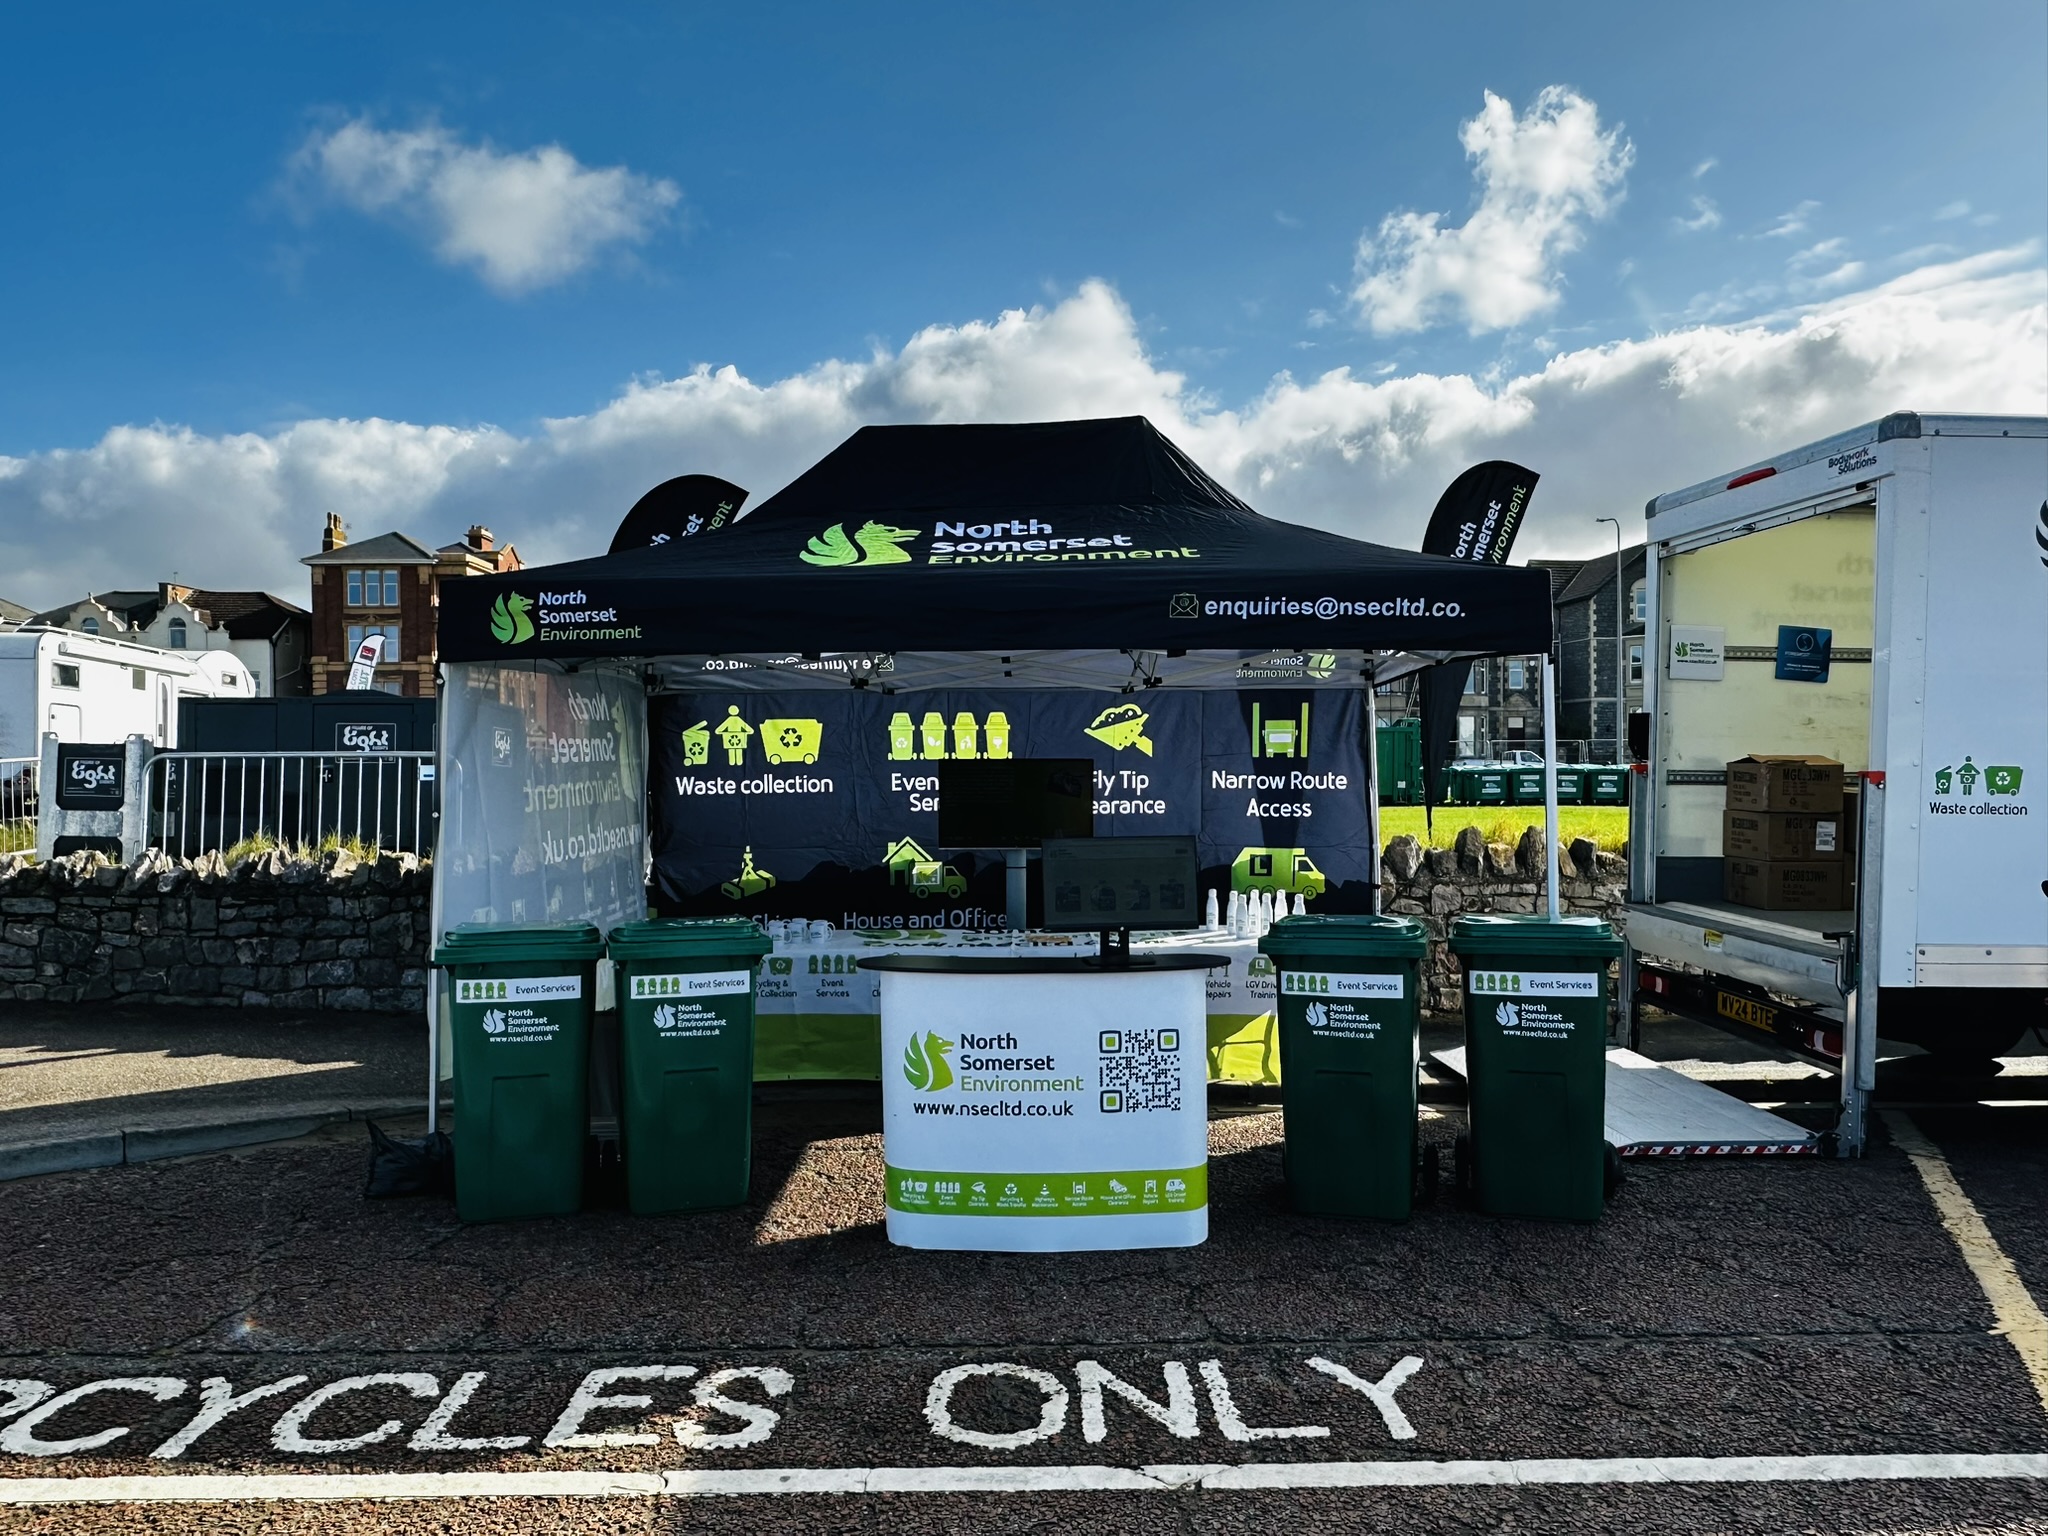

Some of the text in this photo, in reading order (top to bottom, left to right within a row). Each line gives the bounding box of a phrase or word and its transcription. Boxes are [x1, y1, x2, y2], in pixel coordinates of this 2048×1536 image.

[1828, 447, 1870, 468] Bodywork
[1838, 456, 1877, 474] Solutions
[934, 519, 1053, 538] North
[1472, 500, 1501, 561] merset
[930, 534, 1133, 553] Somerset
[1450, 522, 1477, 558] orth
[928, 547, 1200, 565] Environment
[539, 590, 586, 605] North
[539, 608, 617, 624] Somerset
[1204, 596, 1466, 620] enquiries@nsecltd.co.
[540, 625, 642, 641] Environment
[675, 773, 833, 796] Waste collection
[891, 772, 940, 791] Even
[1119, 770, 1149, 796] Tip
[1212, 770, 1348, 790] Narrow Route
[909, 793, 940, 812] Ser
[1092, 800, 1166, 815] earance
[1247, 798, 1312, 818] Access
[1929, 802, 2028, 815] Waste collection
[843, 908, 1007, 930] House and Office
[515, 984, 576, 995] Event Services
[688, 979, 745, 989] Event Services
[821, 979, 844, 987] Event
[1337, 980, 1398, 991] Event Services
[1529, 980, 1593, 989] Event Services
[760, 989, 797, 998] Collection
[816, 989, 850, 998] Services
[508, 1009, 533, 1017] North
[677, 1003, 702, 1012] North
[1329, 1003, 1354, 1012] North
[1521, 1003, 1547, 1011] North
[1751, 1003, 1773, 1027] BTE
[508, 1016, 548, 1025] Somerset
[677, 1011, 716, 1020] Somerset
[677, 1018, 727, 1028] Environment
[1329, 1012, 1369, 1021] Somerset
[1521, 1011, 1562, 1020] Somerset
[508, 1024, 560, 1033] Environment
[1330, 1020, 1381, 1030] Environment
[1521, 1019, 1575, 1030] Environment
[960, 1033, 1018, 1050] North
[960, 1055, 1055, 1071] Somerset
[961, 1075, 1085, 1092] Environment
[914, 1100, 1074, 1117] www.nsecltd.co.uk
[0, 1356, 1425, 1460] CYCLES ONLY
